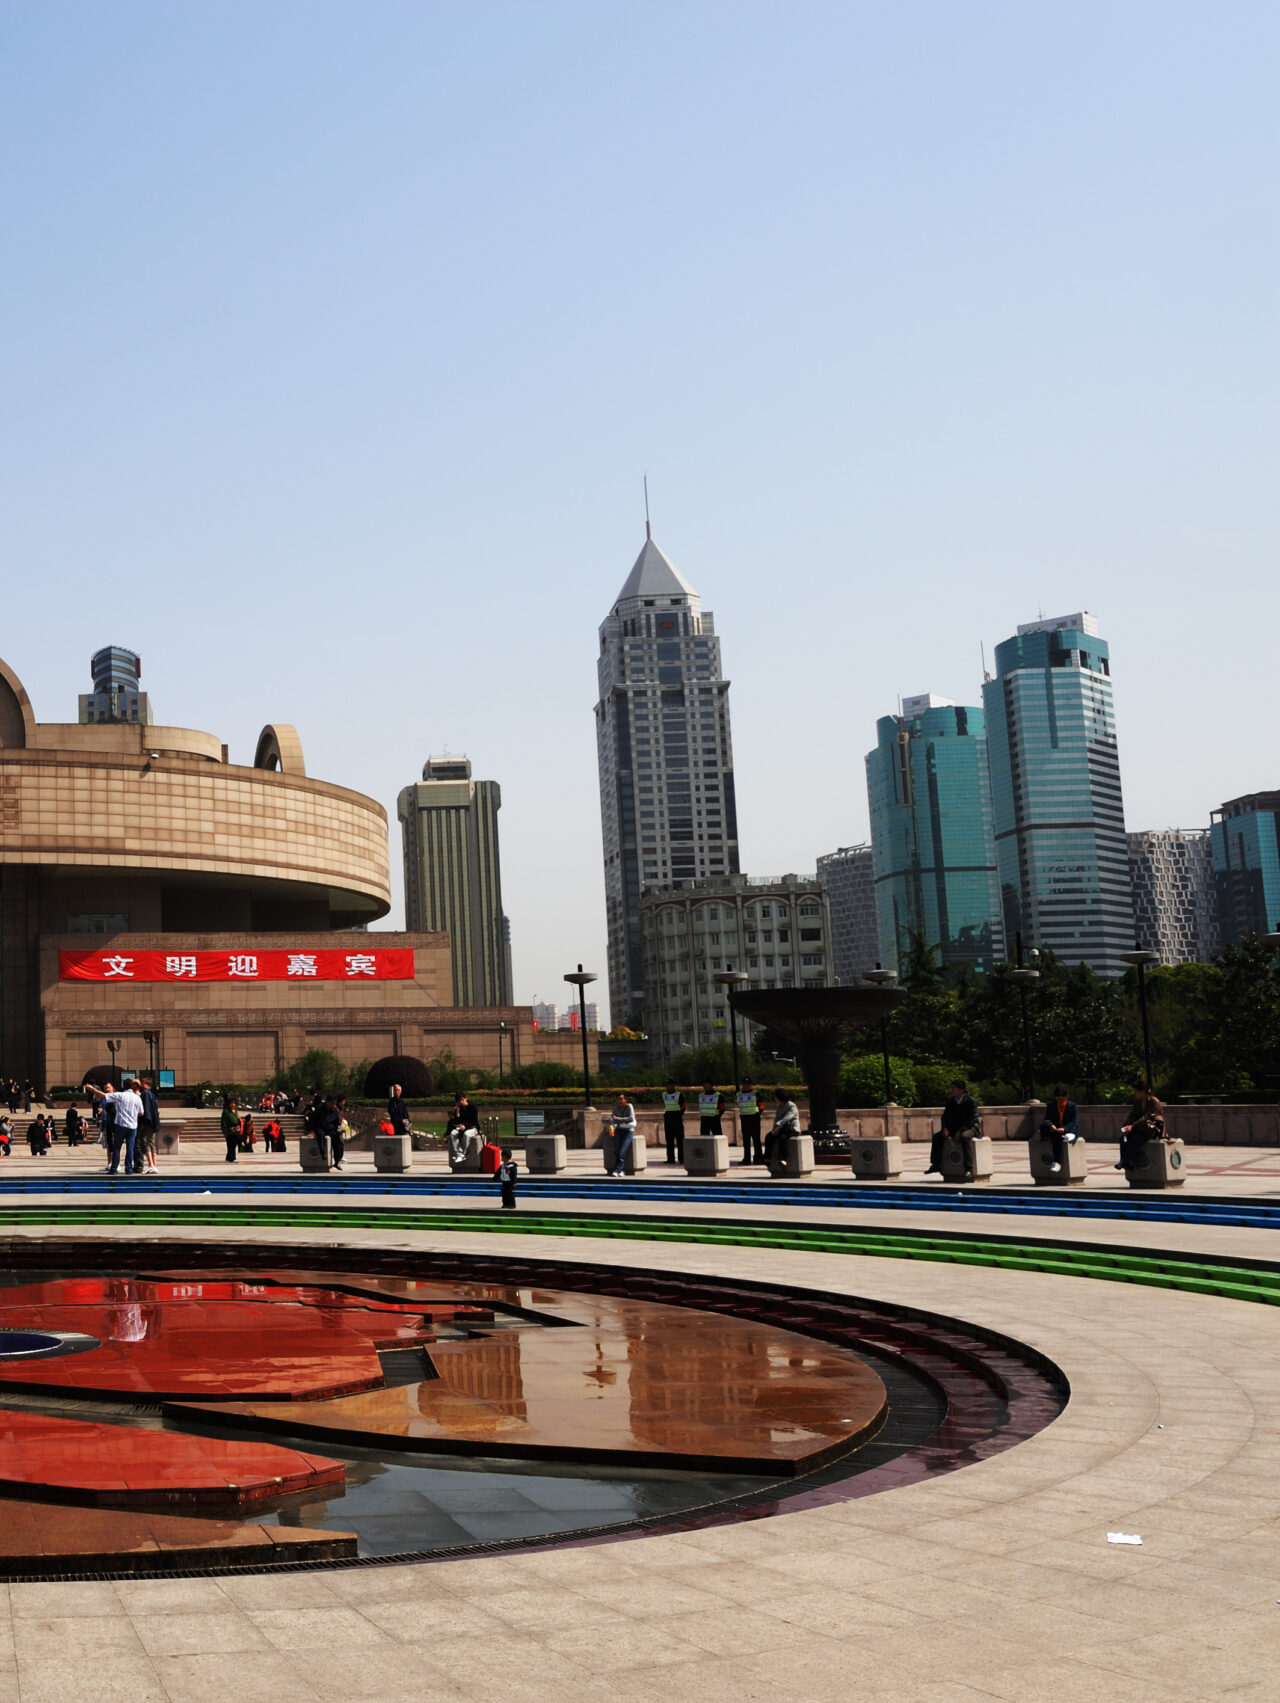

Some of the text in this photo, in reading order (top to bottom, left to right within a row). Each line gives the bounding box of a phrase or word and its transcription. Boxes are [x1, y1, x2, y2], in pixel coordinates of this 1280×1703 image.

[102, 953, 377, 977] 文明迎嘉宾
